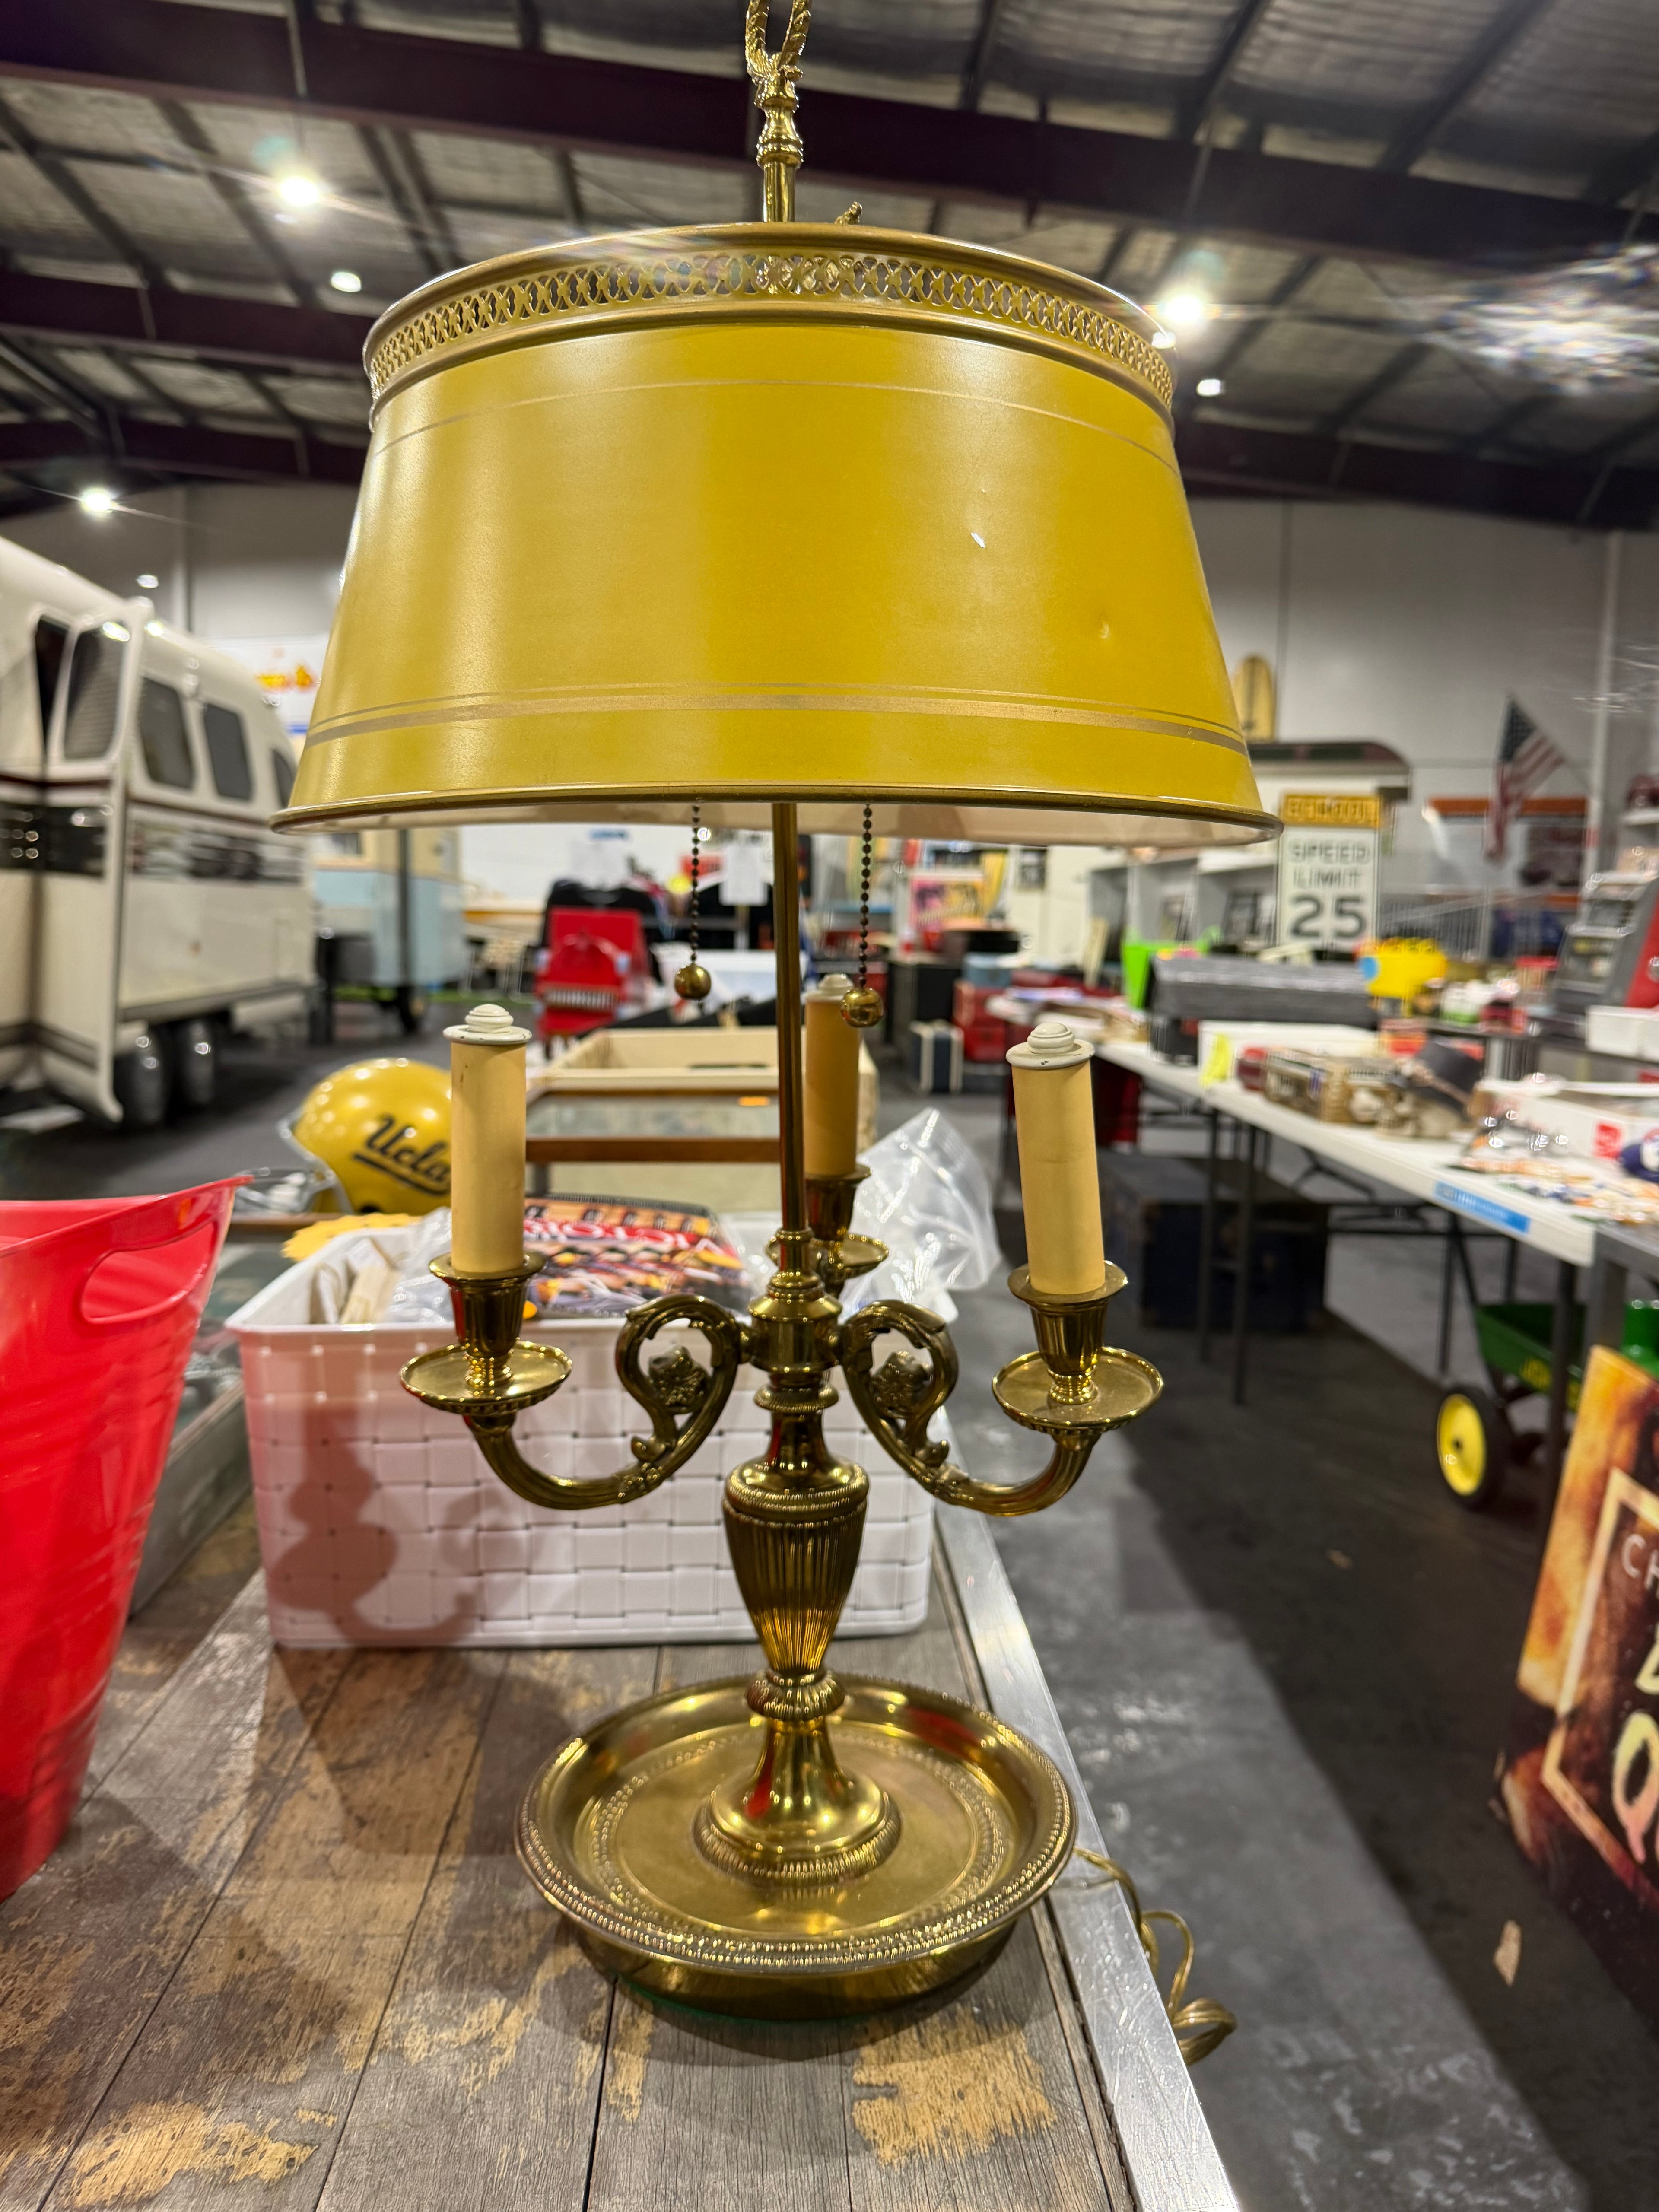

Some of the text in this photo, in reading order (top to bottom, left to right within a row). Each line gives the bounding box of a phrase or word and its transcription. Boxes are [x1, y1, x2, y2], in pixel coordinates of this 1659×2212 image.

[1291, 841, 1369, 862] SPEED
[1294, 867, 1361, 887] LIMIT
[1290, 893, 1367, 938] 25
